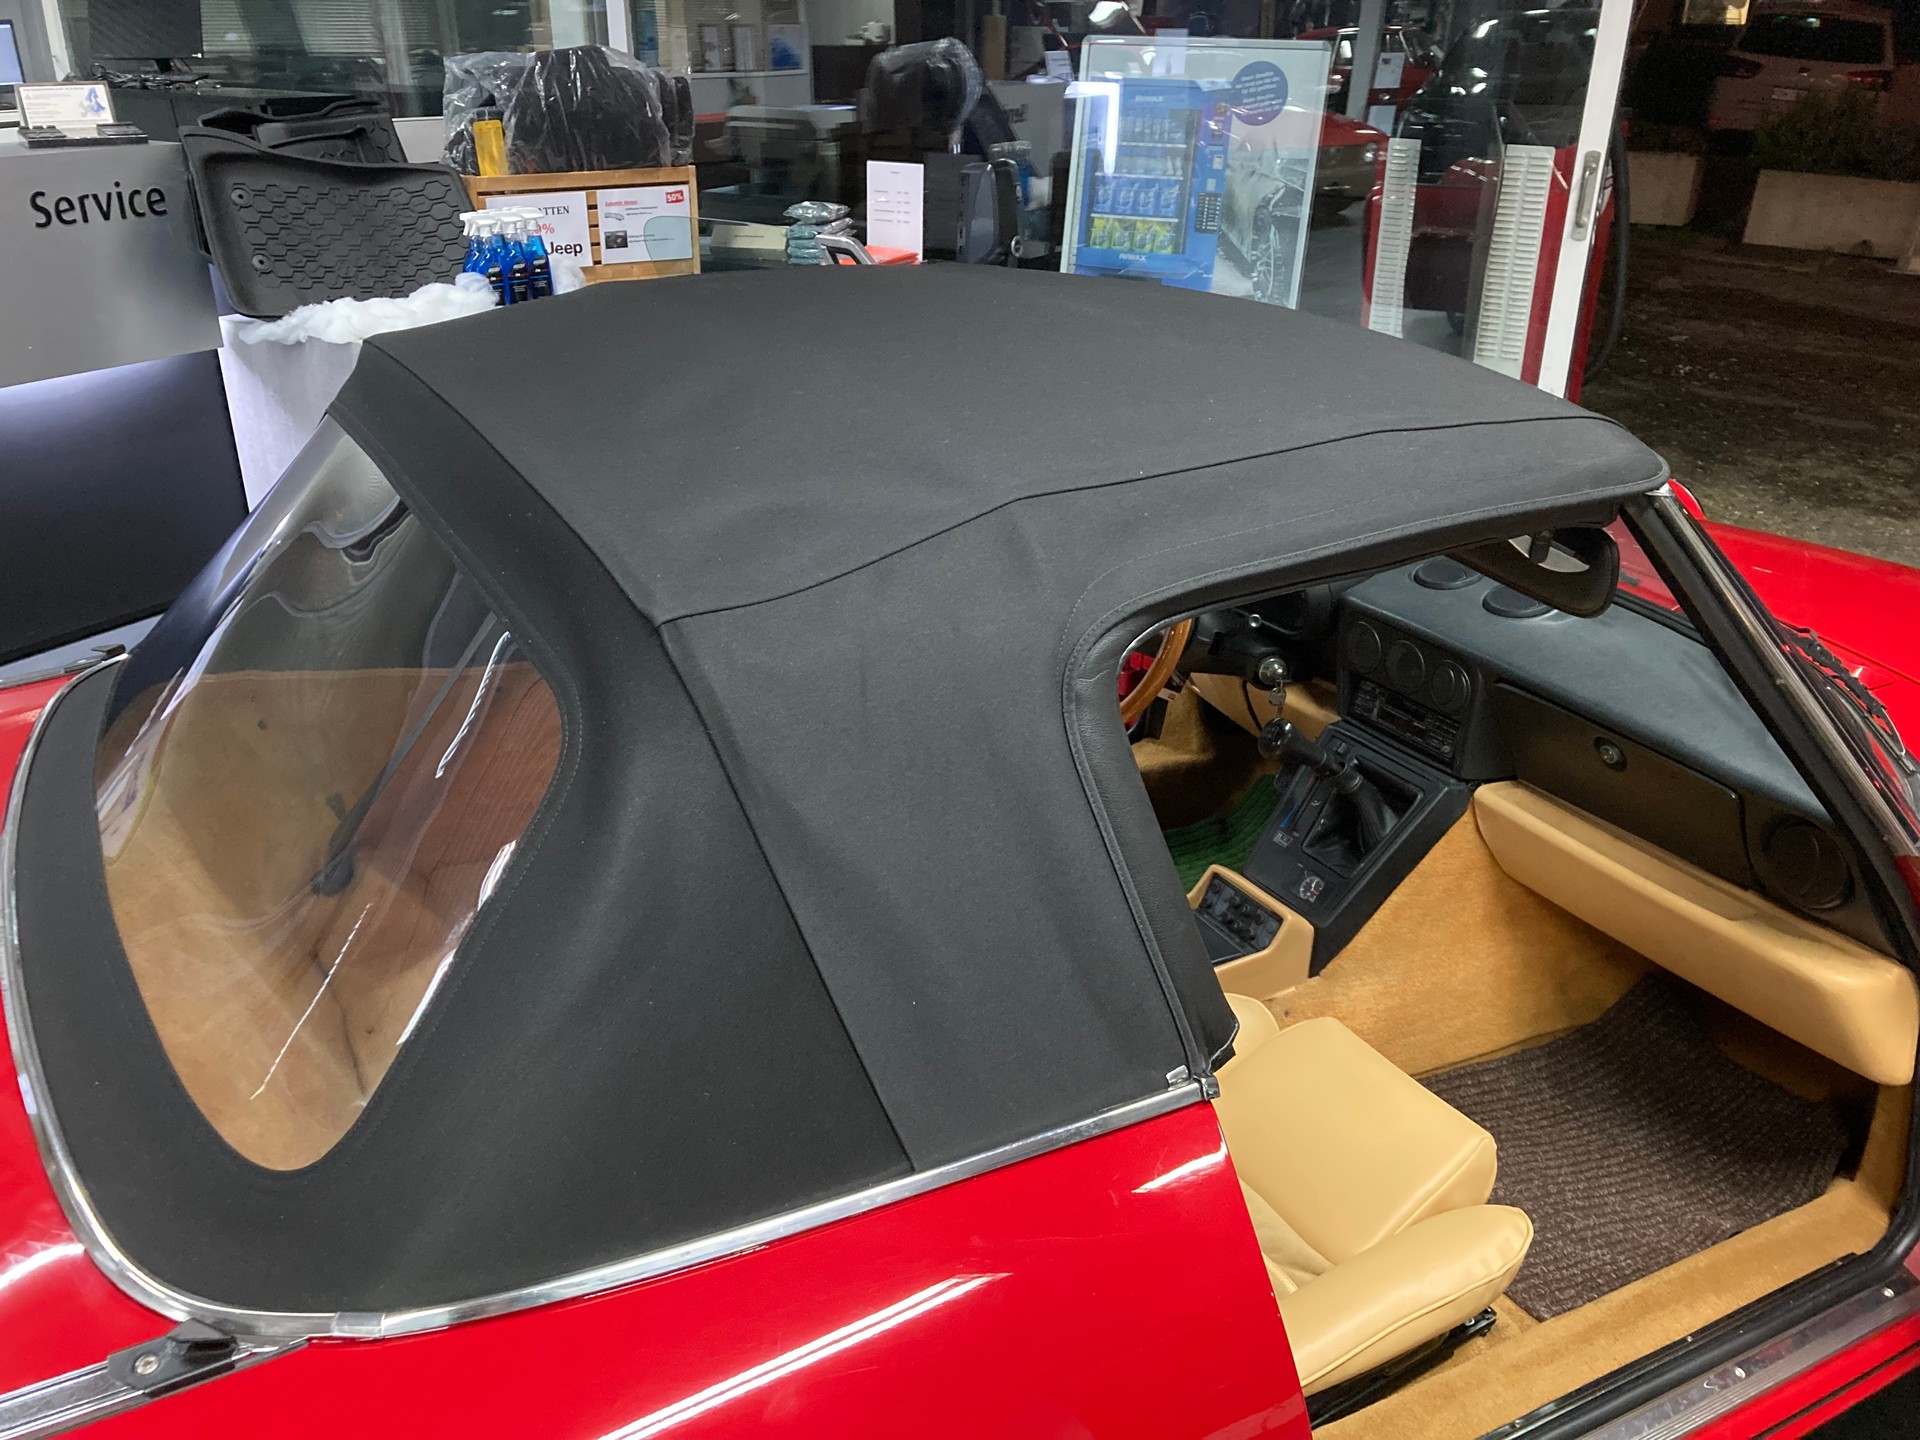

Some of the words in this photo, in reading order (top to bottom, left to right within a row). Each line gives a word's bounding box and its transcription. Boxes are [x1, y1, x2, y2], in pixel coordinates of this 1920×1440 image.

[667, 192, 682, 202] 50%
[30, 181, 168, 228] Service
[547, 242, 583, 256] Jeep
